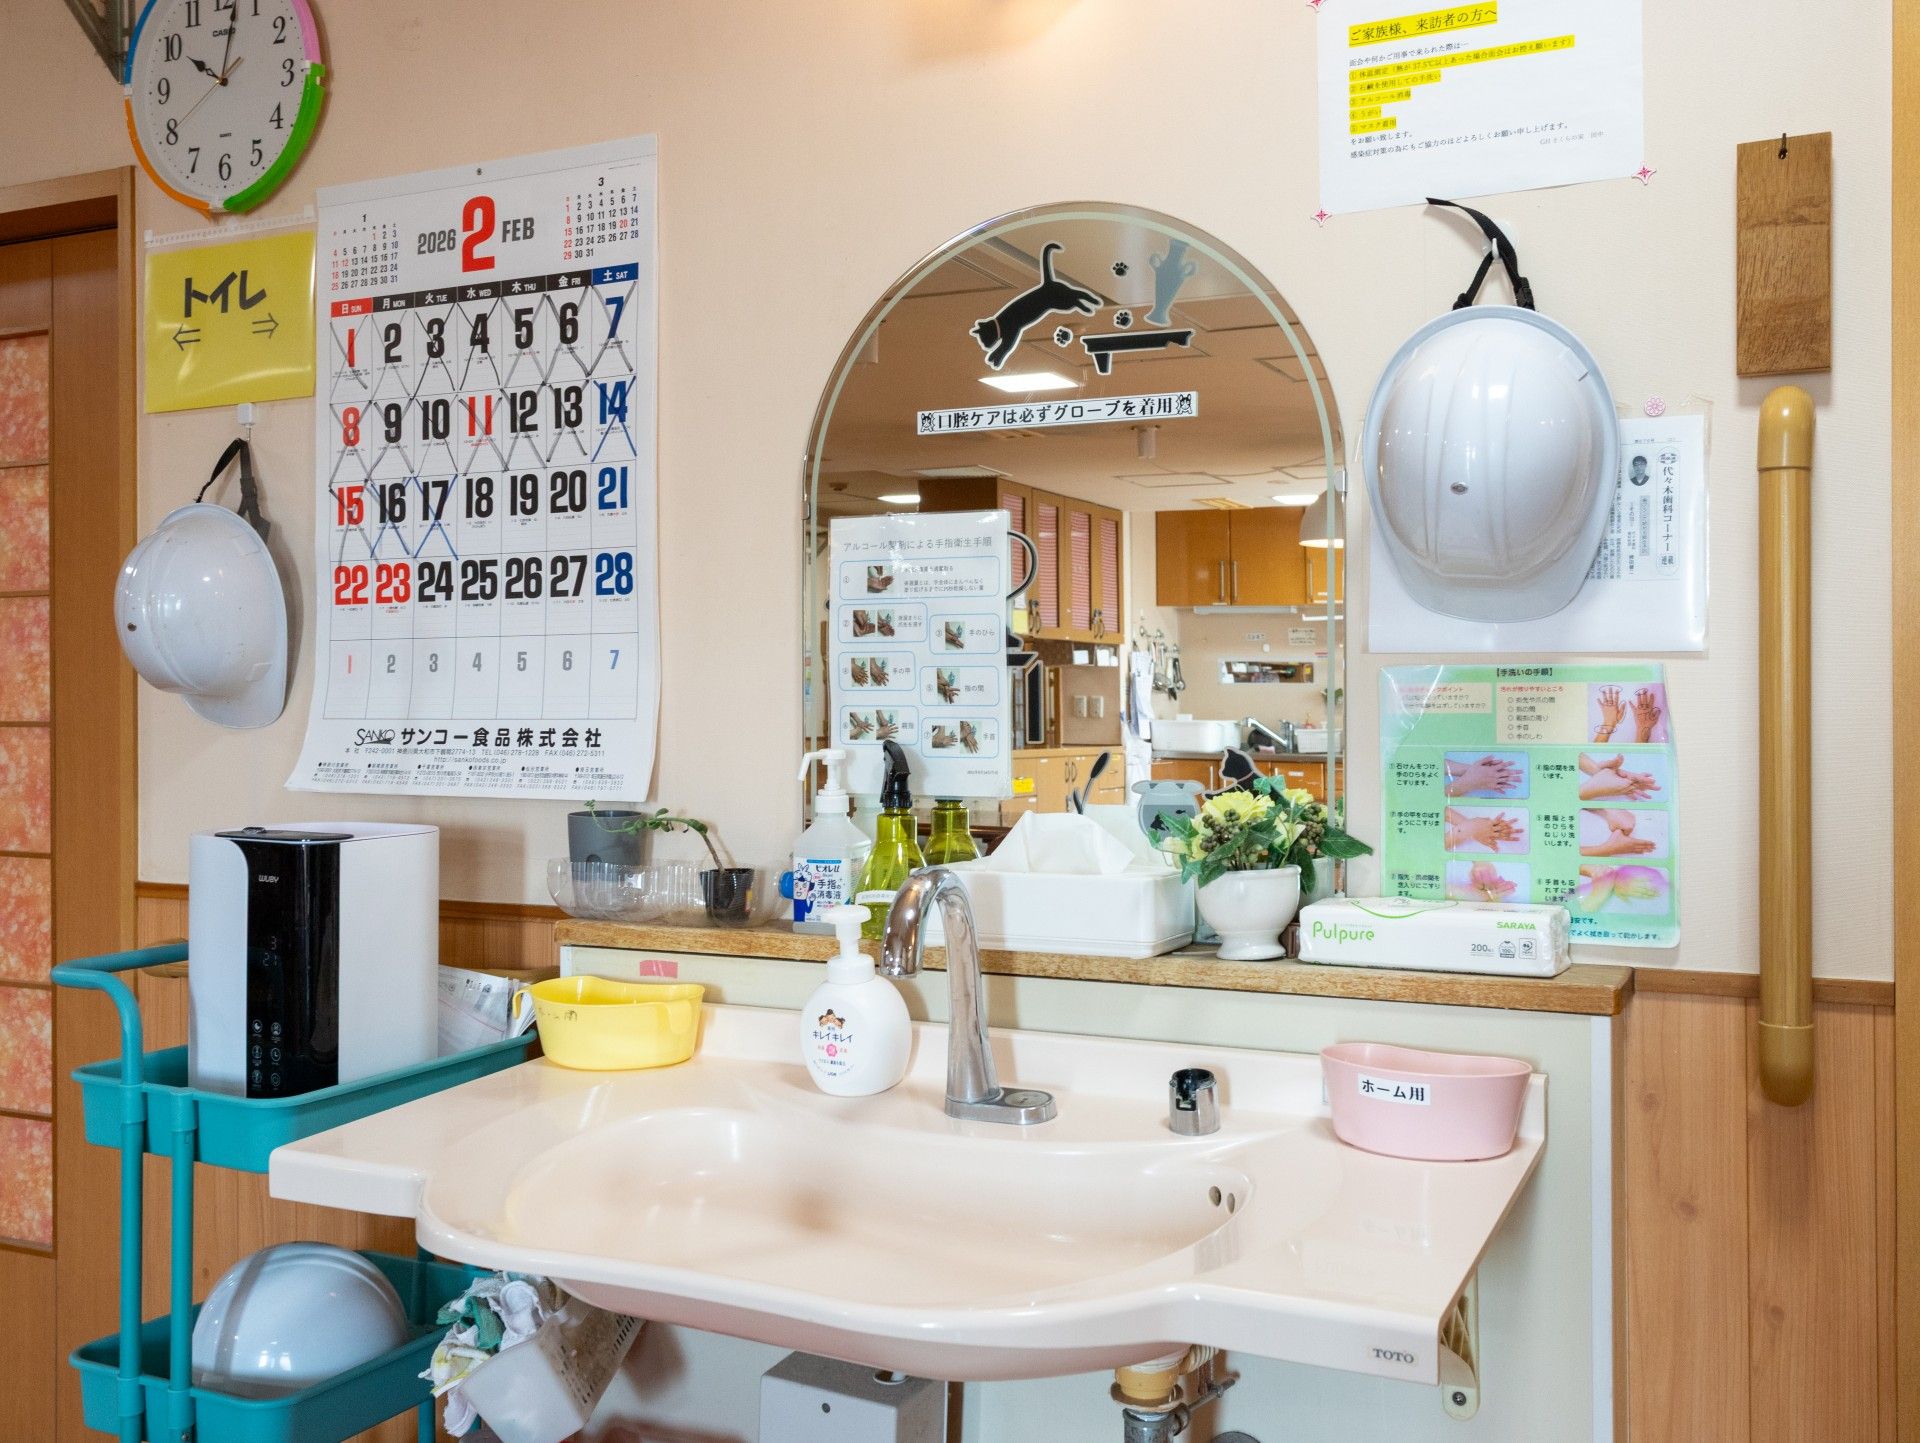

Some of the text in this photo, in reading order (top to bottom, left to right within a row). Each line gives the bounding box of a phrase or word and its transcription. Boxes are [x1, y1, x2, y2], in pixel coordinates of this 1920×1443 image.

[185, 0, 201, 28] 11
[213, 27, 236, 37] CASO
[273, 16, 286, 45] 2
[164, 33, 182, 62] 10
[281, 58, 294, 87] 3
[157, 78, 170, 105] 9
[269, 102, 284, 130] 4
[166, 118, 178, 145] 8
[188, 147, 200, 174] 7
[218, 153, 231, 181] 6
[250, 139, 262, 167] 5
[598, 177, 604, 186] 3
[417, 217, 535, 255] 2026 FEB
[461, 195, 496, 273] 2
[184, 270, 267, 318] トイレ
[341, 270, 628, 314] 日 SUN 月 MON 火 TUE 水 WED 木 THU 金 FRI 土 SAT
[347, 296, 624, 368] 1 2 3 4 5 6 7
[342, 380, 628, 447] 8 9 10 11 12 13 14
[937, 397, 1172, 429] 口腔ケアは必ずグローブを着用
[337, 466, 628, 526] 15 16 17 18 19 20 21
[334, 551, 634, 606] 22 23 24 25 26 27 28
[348, 649, 620, 674] 1 2 3 4 5 6 7
[354, 727, 601, 748] SANKO サンコー食品株式会社
[817, 879, 841, 889] 手指の
[817, 890, 841, 900] 消毒液
[1313, 920, 1375, 944] Pulpure
[1497, 921, 1536, 930] SARAYA
[813, 1030, 853, 1043] キレイキレイ
[1362, 1079, 1425, 1101] ホーム用
[1373, 1347, 1415, 1364] TOTO
